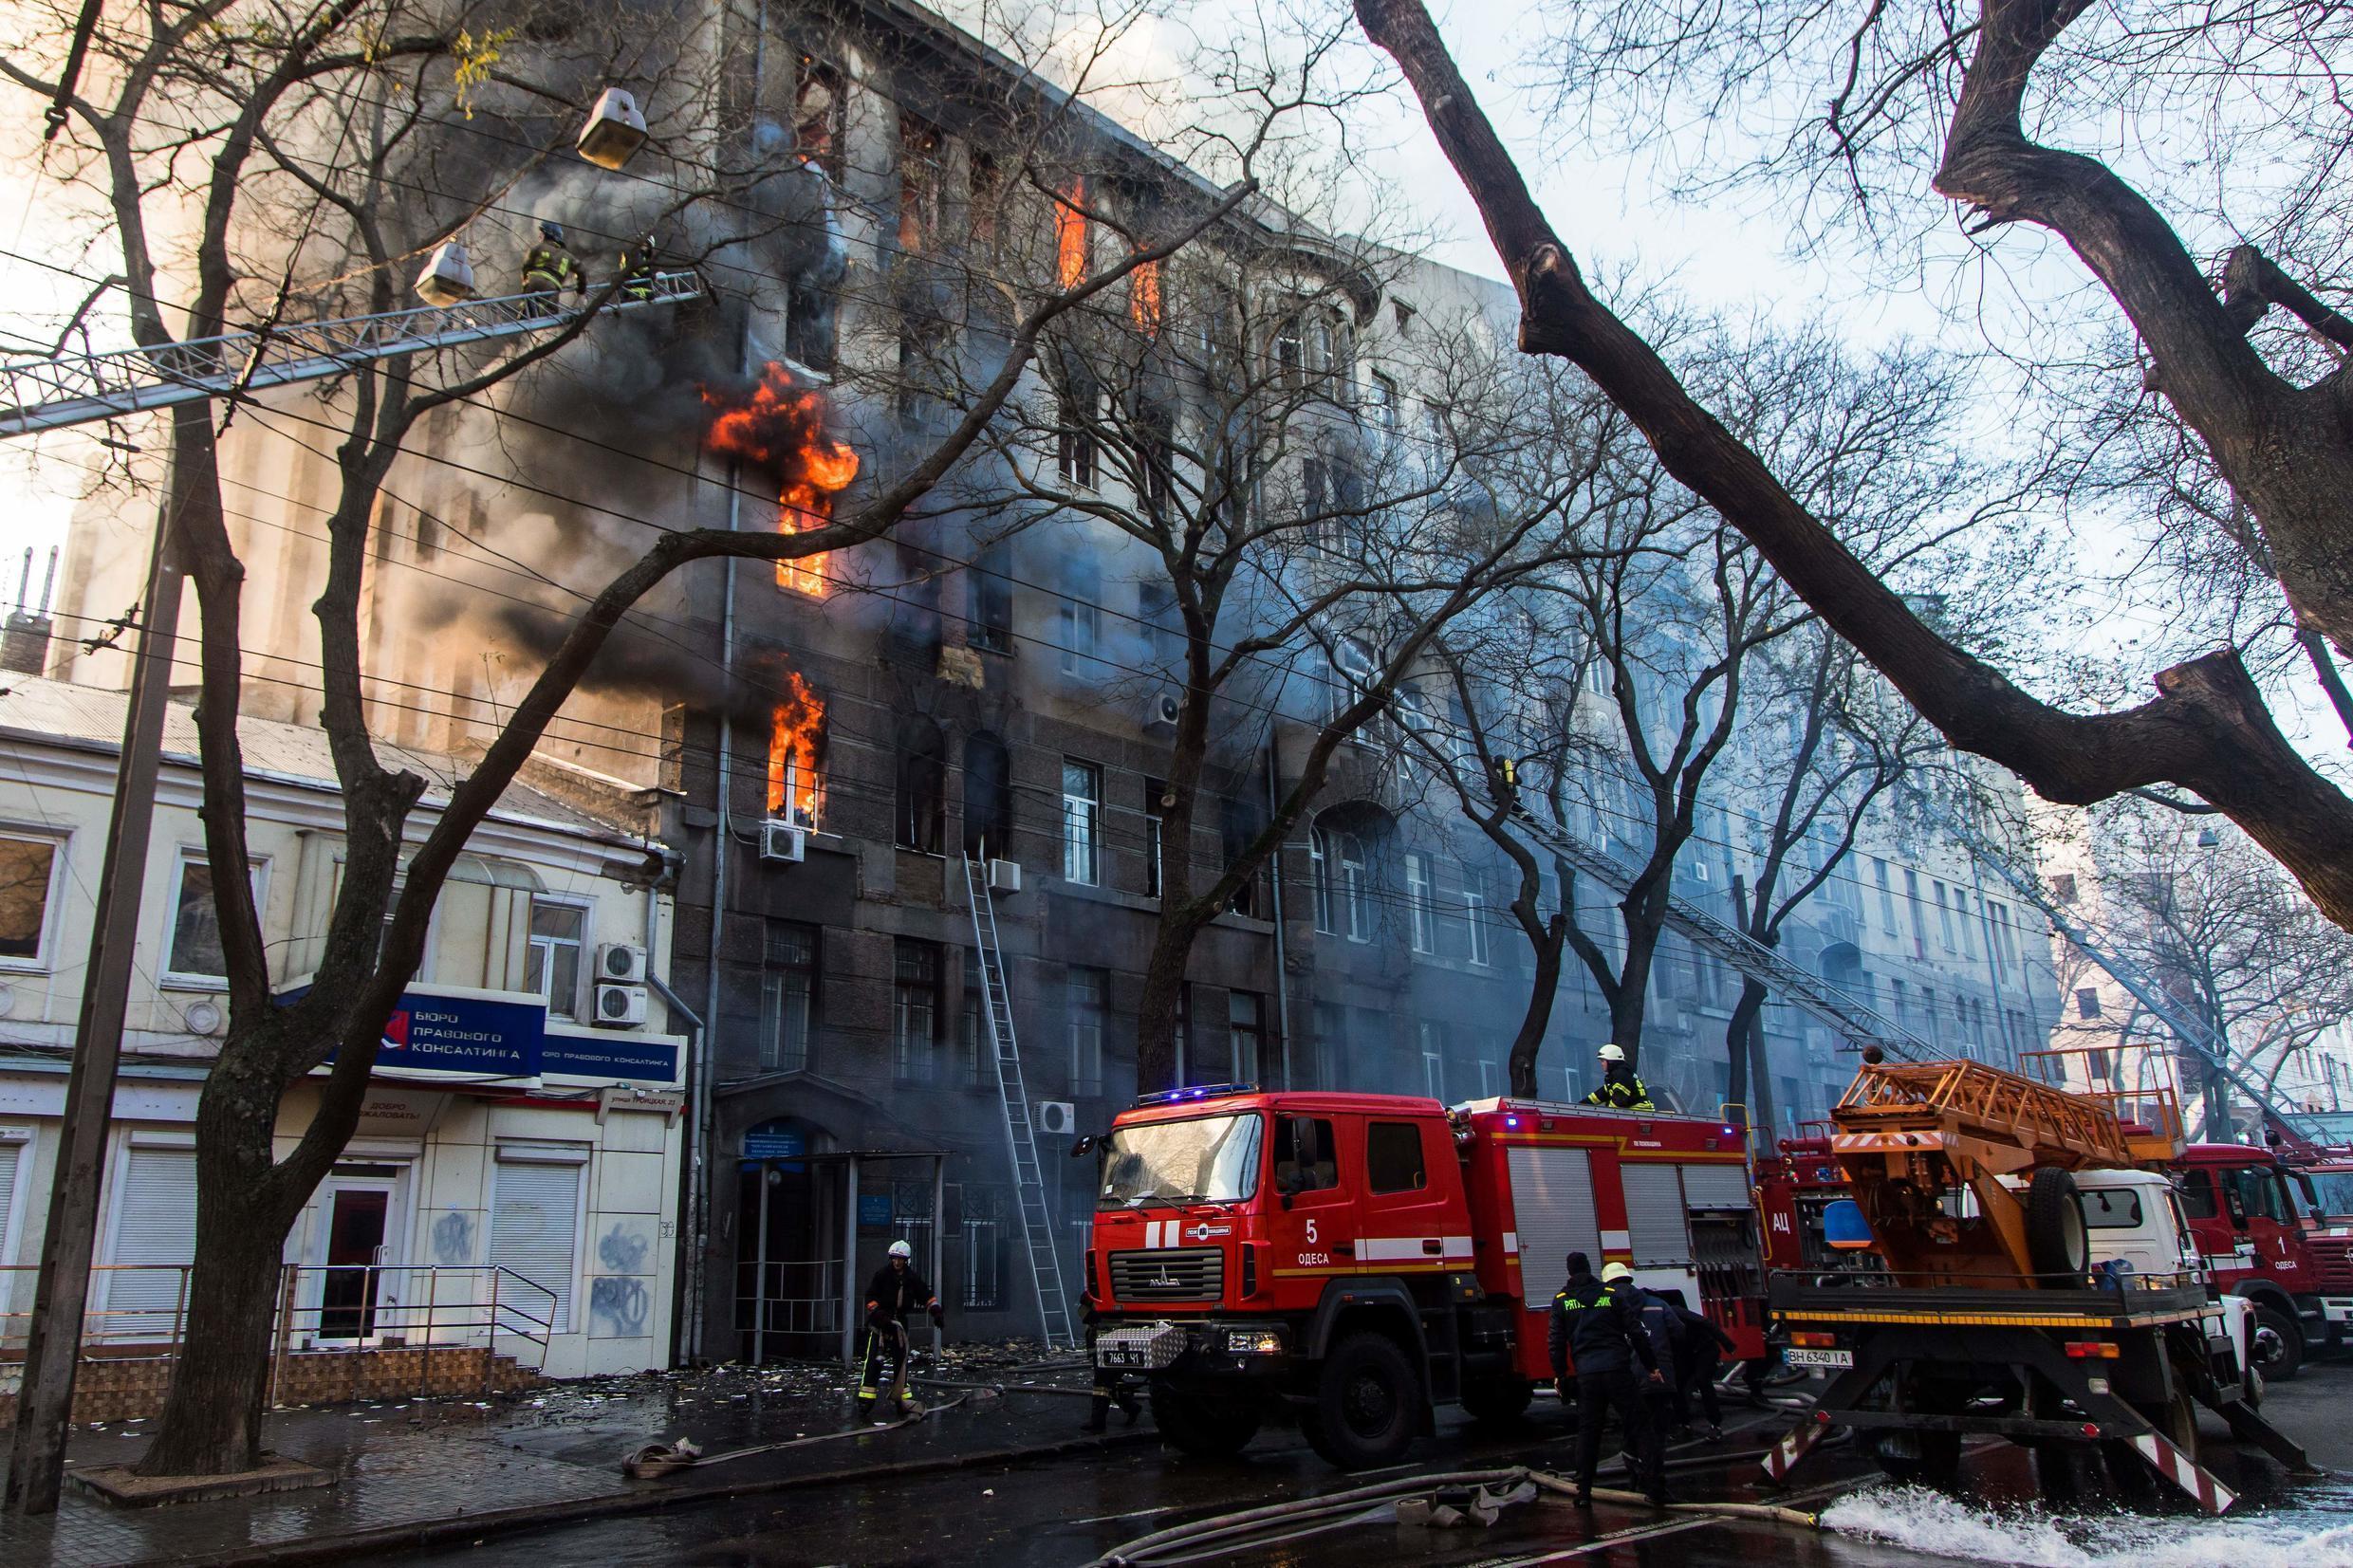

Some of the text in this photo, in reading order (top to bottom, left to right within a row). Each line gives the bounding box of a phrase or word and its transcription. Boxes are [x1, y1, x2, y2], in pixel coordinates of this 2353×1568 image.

[415, 1011, 459, 1024] БЮРО
[413, 1027, 502, 1042] ПРАВОВОГО
[412, 1042, 521, 1060] КОНСАЛТИНГА
[564, 1053, 611, 1062] ПРАВОВОГО
[614, 1057, 669, 1066] КОНСАЛТИНГА
[1773, 1212, 1790, 1235] АЦ
[1306, 1219, 1318, 1244] 5
[2278, 1236, 2286, 1255] 1
[1298, 1253, 1329, 1266] ОДЕСА
[2275, 1261, 2297, 1271] ОДЕСА
[1108, 1353, 1125, 1363] 7663
[1788, 1351, 1805, 1362] BH
[1806, 1352, 1830, 1363] 6340
